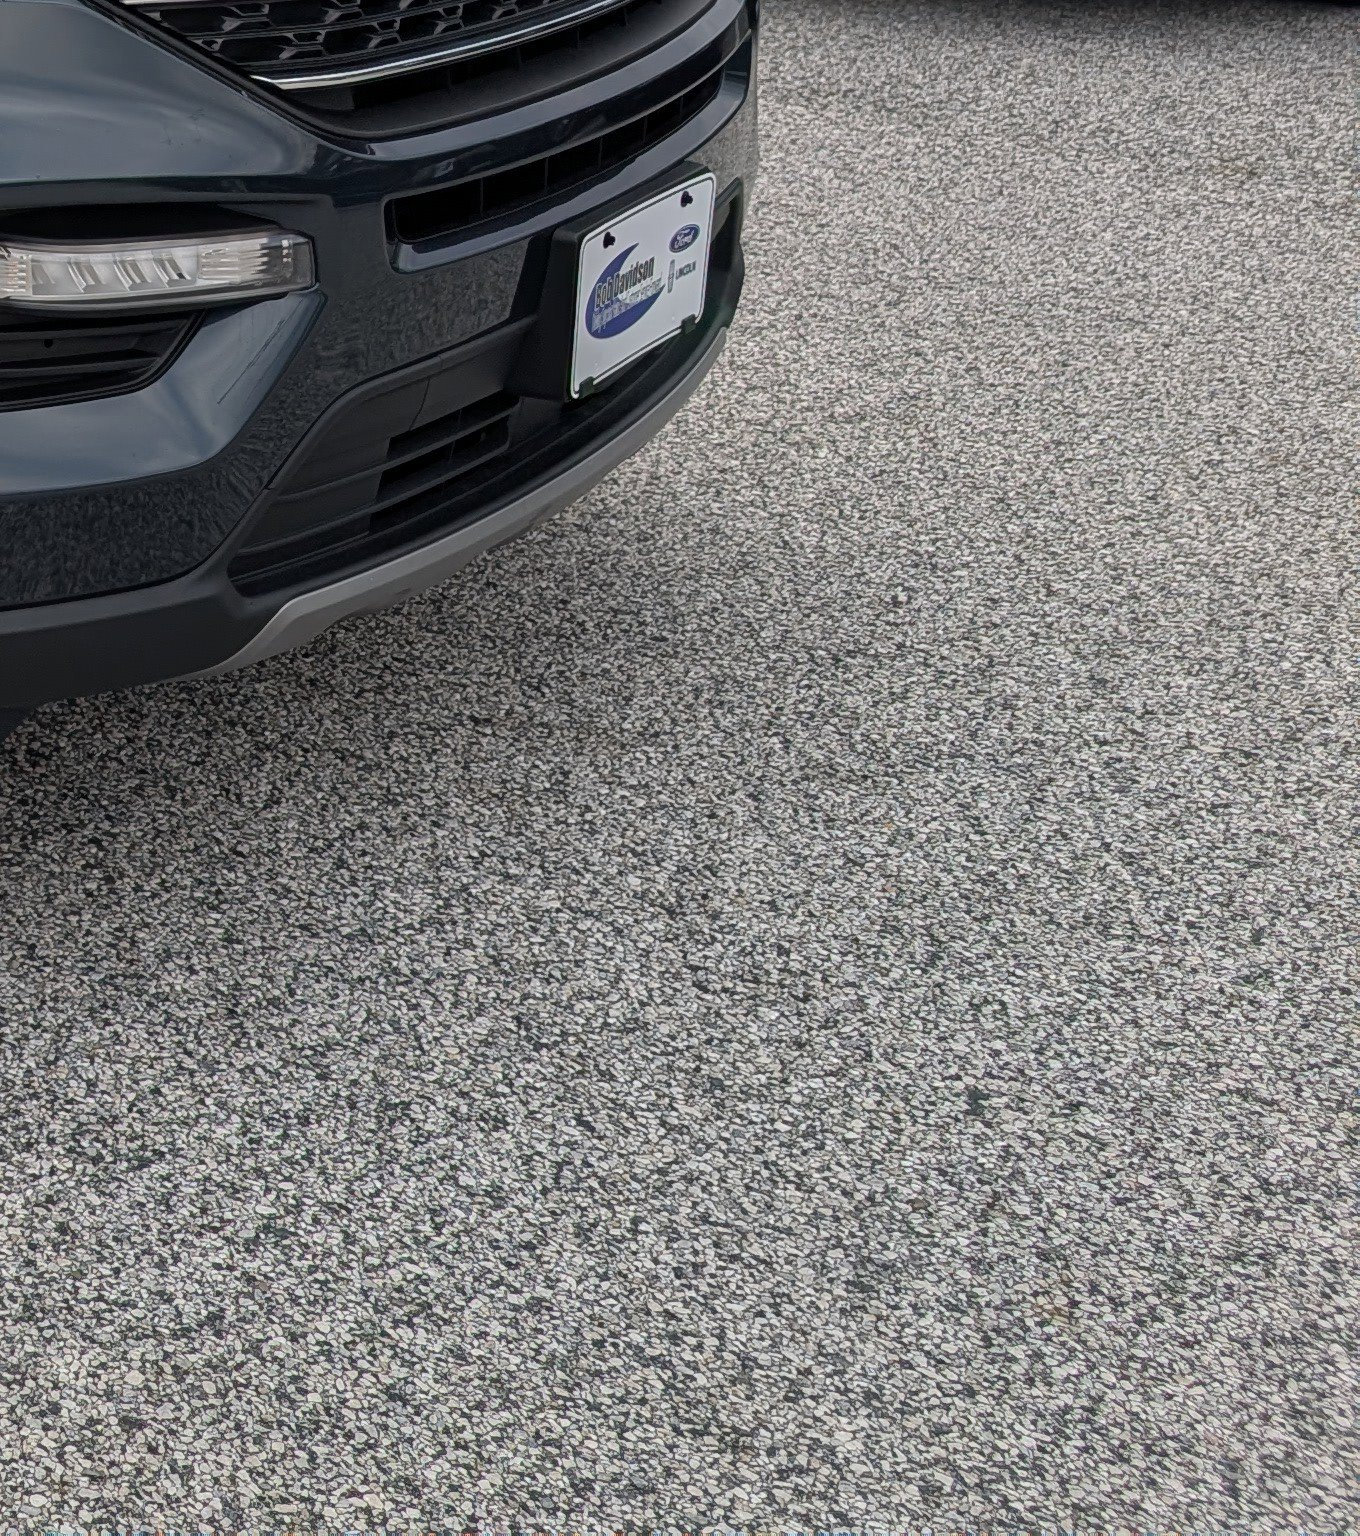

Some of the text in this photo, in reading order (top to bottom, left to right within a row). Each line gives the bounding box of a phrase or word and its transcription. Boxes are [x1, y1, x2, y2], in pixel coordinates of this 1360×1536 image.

[672, 226, 698, 252] Ford
[594, 275, 615, 310] Bob
[613, 255, 656, 297] Davidson
